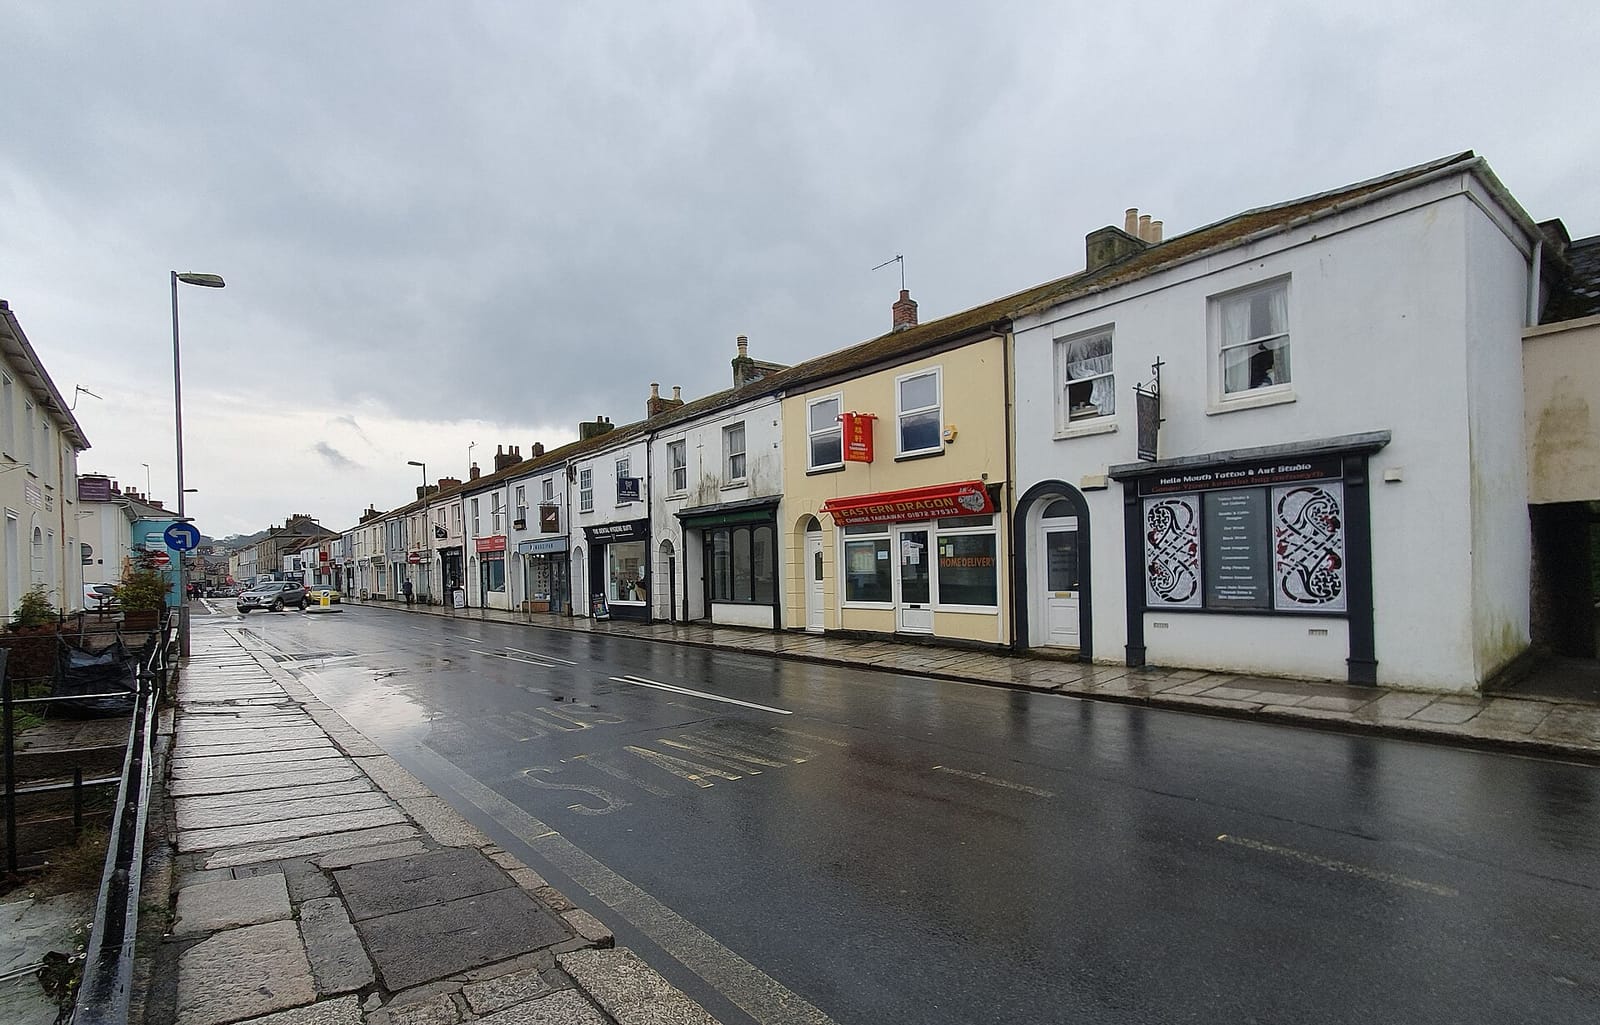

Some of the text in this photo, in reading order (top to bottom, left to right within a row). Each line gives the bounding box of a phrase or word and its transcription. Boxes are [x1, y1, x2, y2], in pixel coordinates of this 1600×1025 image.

[1183, 473, 1212, 483] Mouth
[1214, 470, 1246, 480] Tattoo
[1278, 463, 1312, 473] Studio
[841, 504, 895, 517] EASTERN
[896, 497, 954, 513] DRAGON
[846, 515, 870, 523] CHINESE
[871, 513, 905, 522] TAKEAWAY
